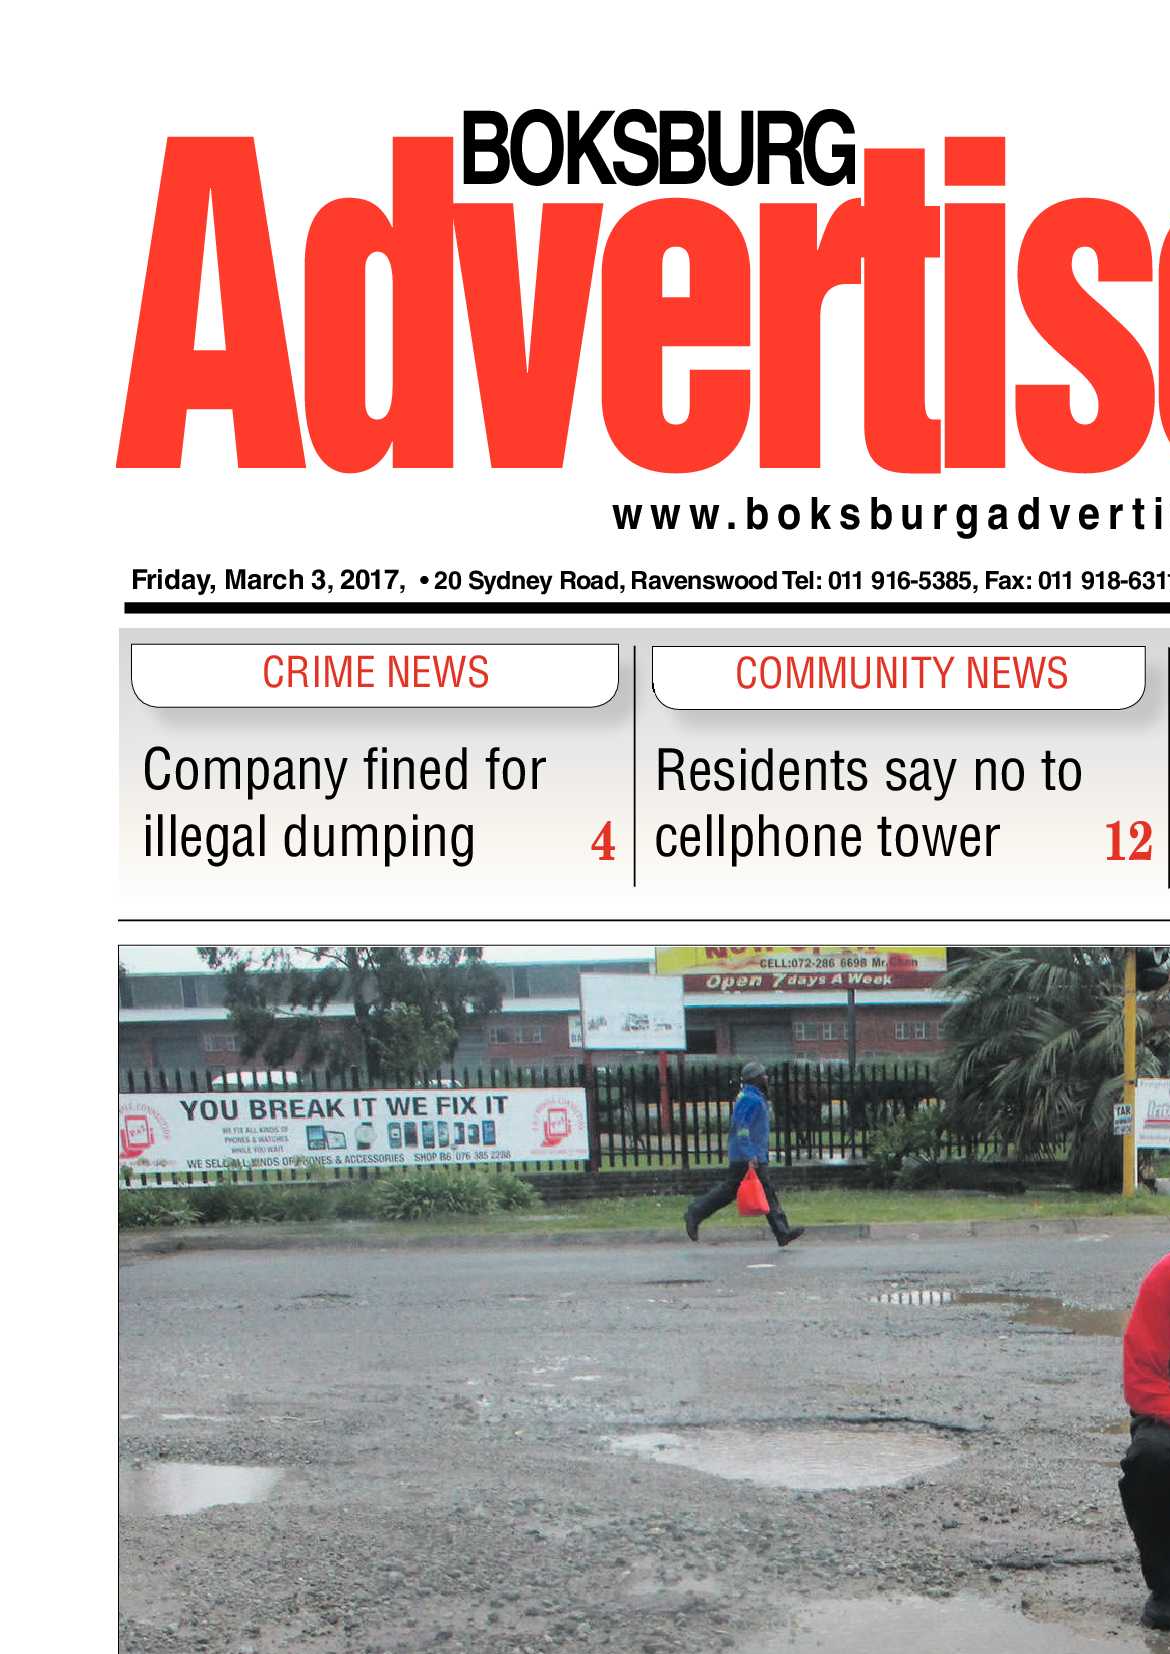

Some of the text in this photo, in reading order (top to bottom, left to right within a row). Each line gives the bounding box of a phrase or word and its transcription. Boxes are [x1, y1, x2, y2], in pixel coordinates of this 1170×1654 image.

[462, 109, 856, 185] BOKSBURG
[133, 569, 215, 595] Friday,
[226, 569, 303, 590] March
[312, 569, 333, 593] 3,
[341, 569, 405, 593] 2017,
[435, 571, 461, 590] 20
[469, 570, 552, 594] Sydney
[561, 571, 625, 593] Road,
[632, 571, 776, 590] Ravenswood
[782, 571, 821, 589] Tel:
[829, 571, 861, 590] 011
[872, 571, 978, 593] 916-5385,
[986, 571, 1031, 589] Fax:
[1039, 571, 1071, 590] 011
[264, 655, 488, 688] CRIME NEWS
[737, 656, 1067, 689] COMMUNITY NEWS
[592, 821, 615, 860] 4
[1106, 821, 1152, 860] 12
[706, 973, 892, 991] Open 7 days A Week
[180, 1096, 508, 1121] YOU BREAK IT WE FIX IT
[187, 1160, 202, 1168] WE
[345, 1153, 405, 1164] ACCESSORIES
[414, 1151, 437, 1160] SHOP
